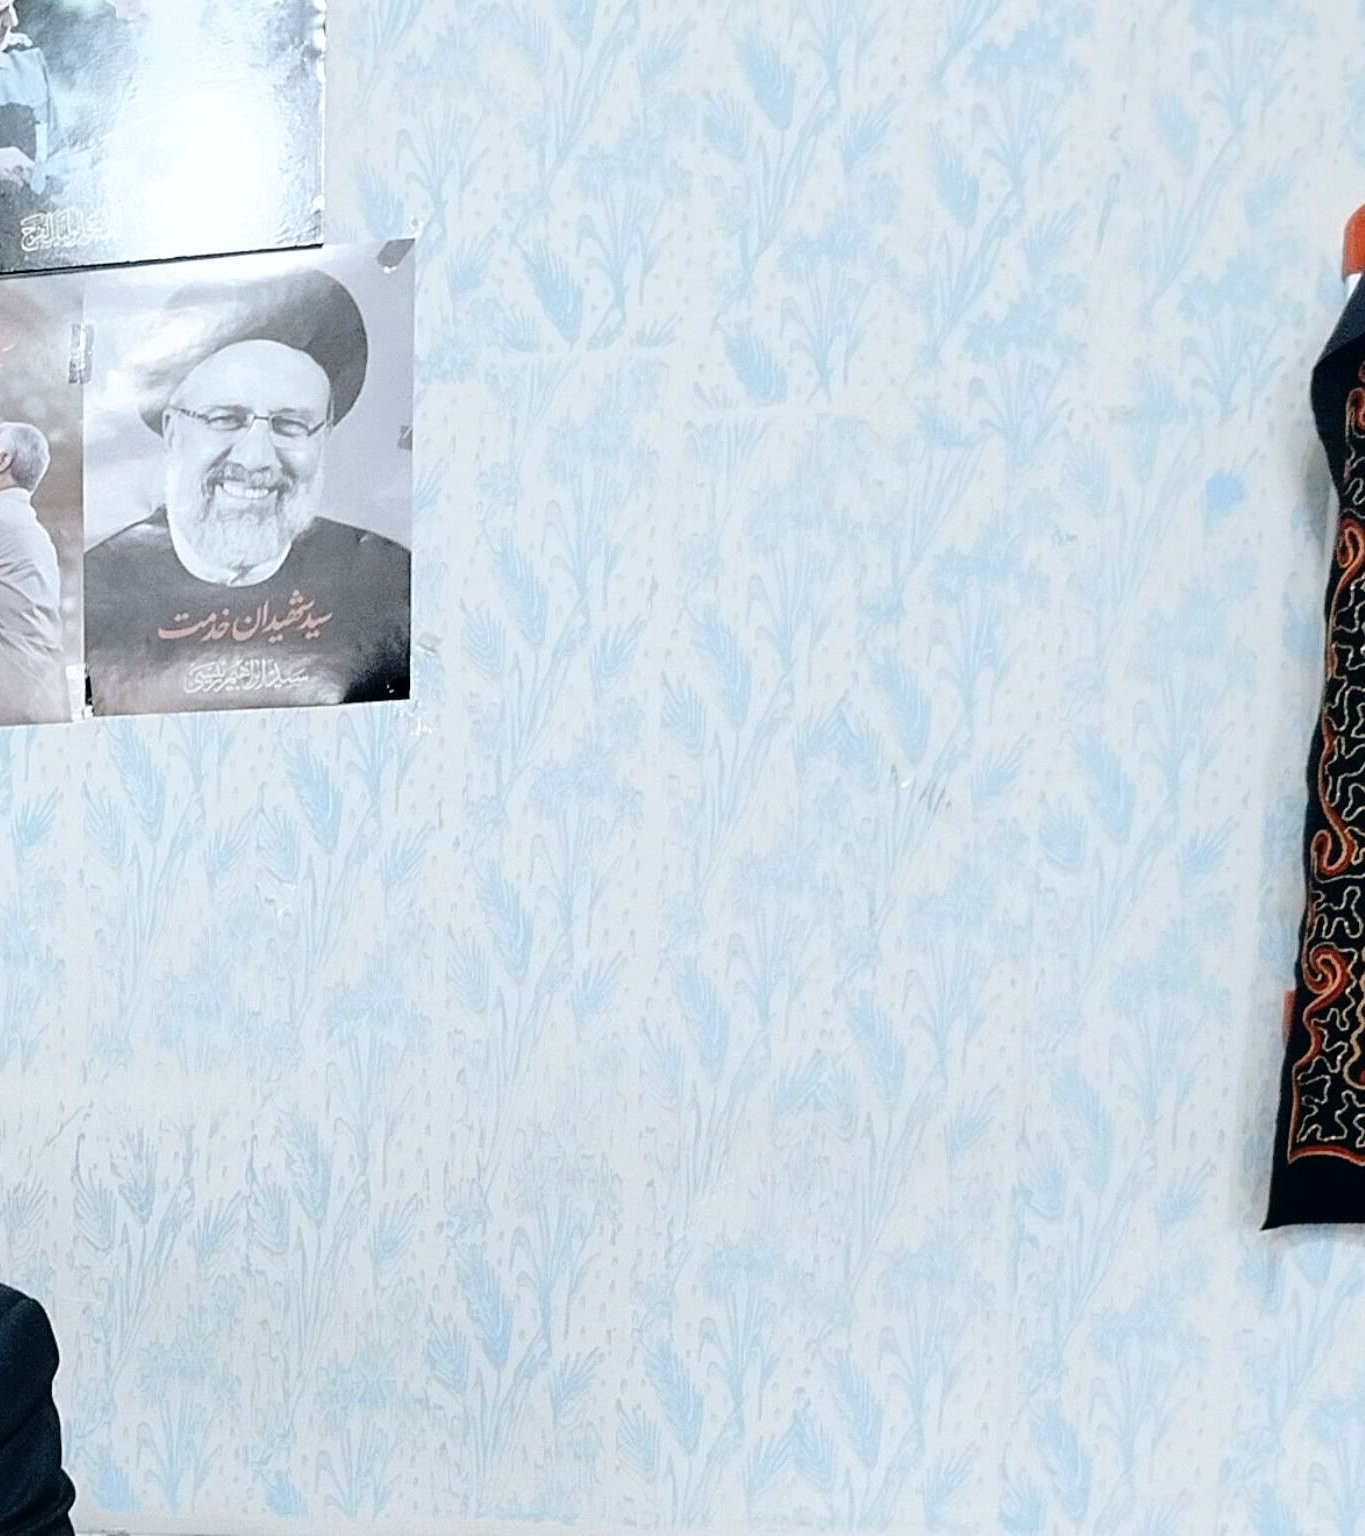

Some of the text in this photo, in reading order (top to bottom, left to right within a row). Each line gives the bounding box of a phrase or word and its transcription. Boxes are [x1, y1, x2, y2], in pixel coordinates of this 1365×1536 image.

[158, 589, 334, 643] سید شهیدان خدمت
